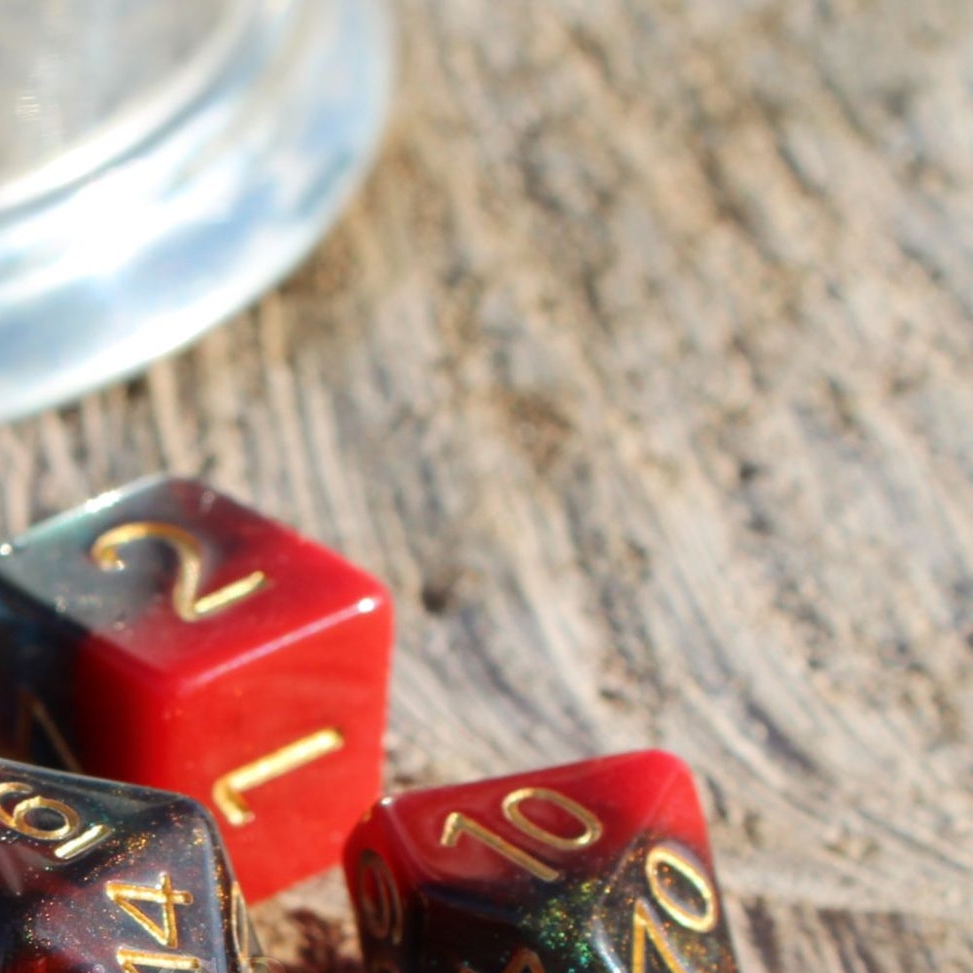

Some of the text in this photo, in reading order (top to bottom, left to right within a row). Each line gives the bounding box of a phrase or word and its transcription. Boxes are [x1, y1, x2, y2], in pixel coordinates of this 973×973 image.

[90, 521, 267, 622] 2
[212, 727, 345, 827] 1
[440, 787, 604, 882] 10
